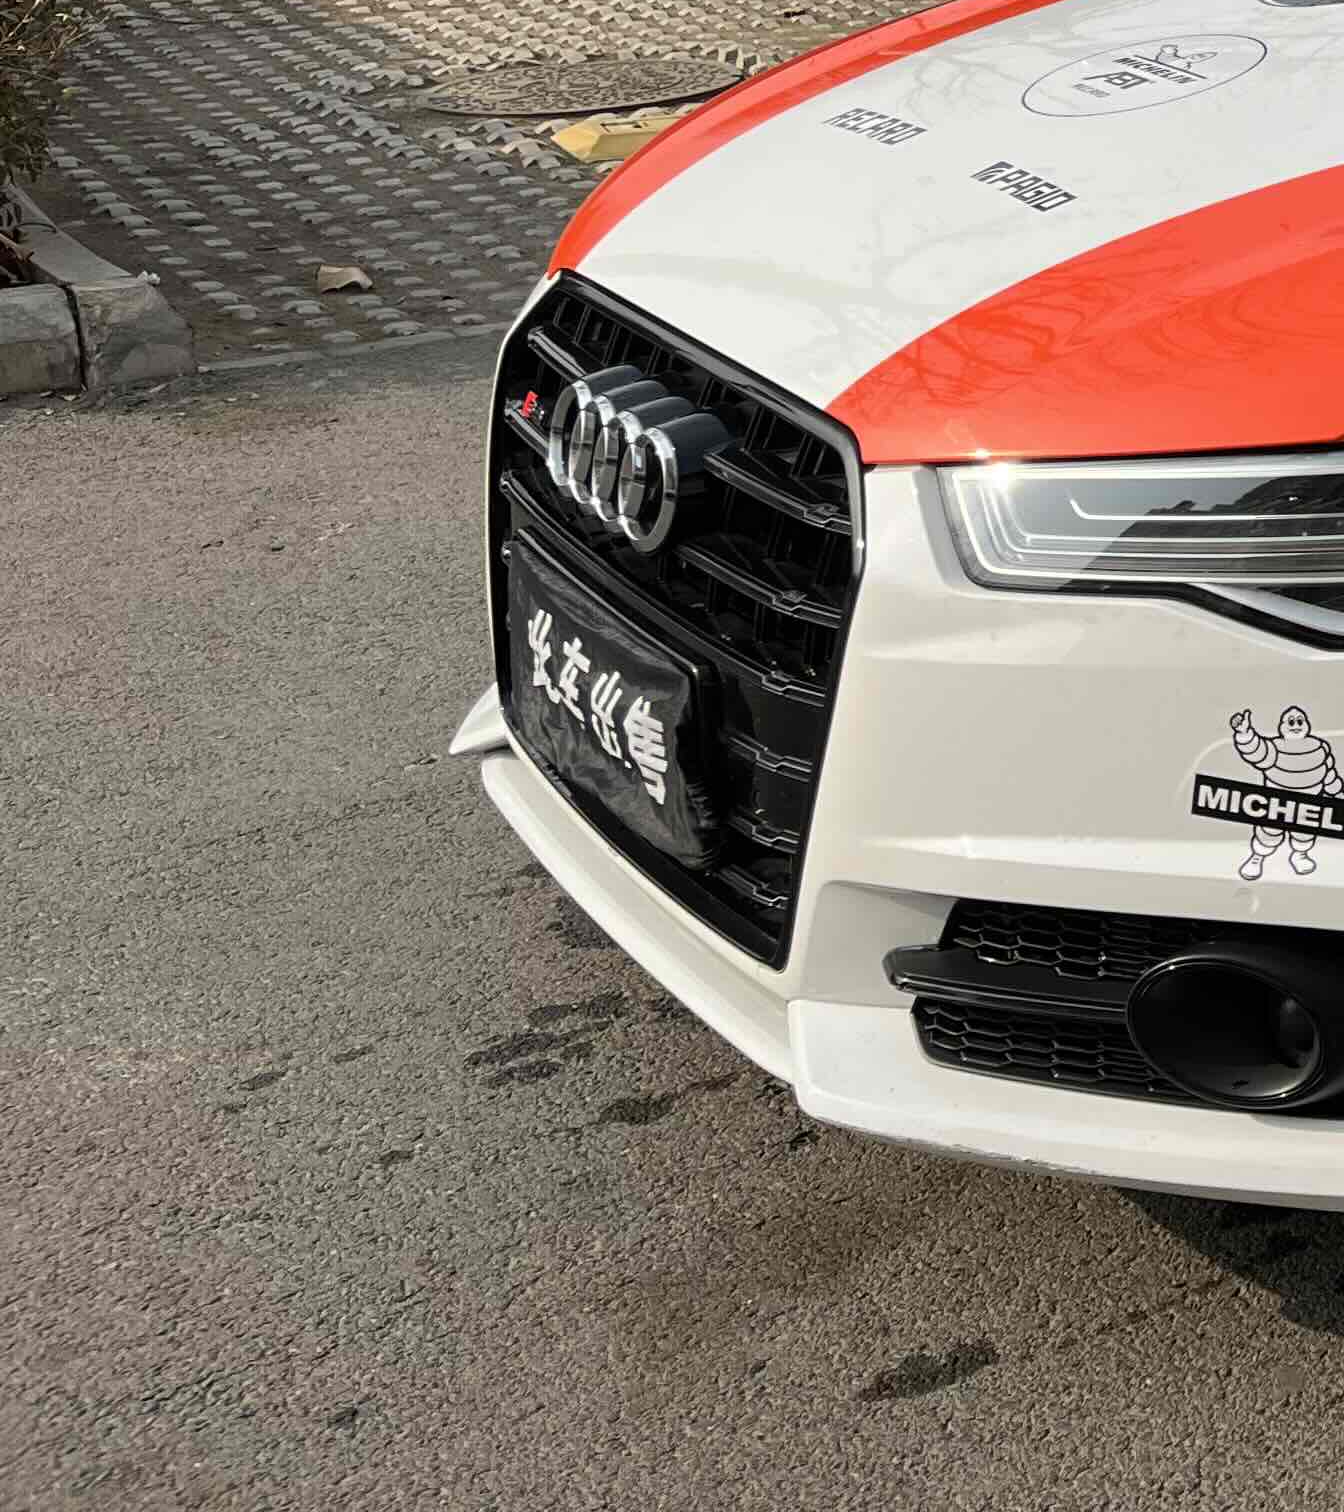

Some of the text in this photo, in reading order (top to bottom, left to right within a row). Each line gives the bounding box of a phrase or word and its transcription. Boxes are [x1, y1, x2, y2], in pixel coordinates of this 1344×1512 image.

[1112, 56, 1196, 85] MICHELIN
[820, 107, 928, 146] RECARO
[527, 608, 669, 806] 此车出售
